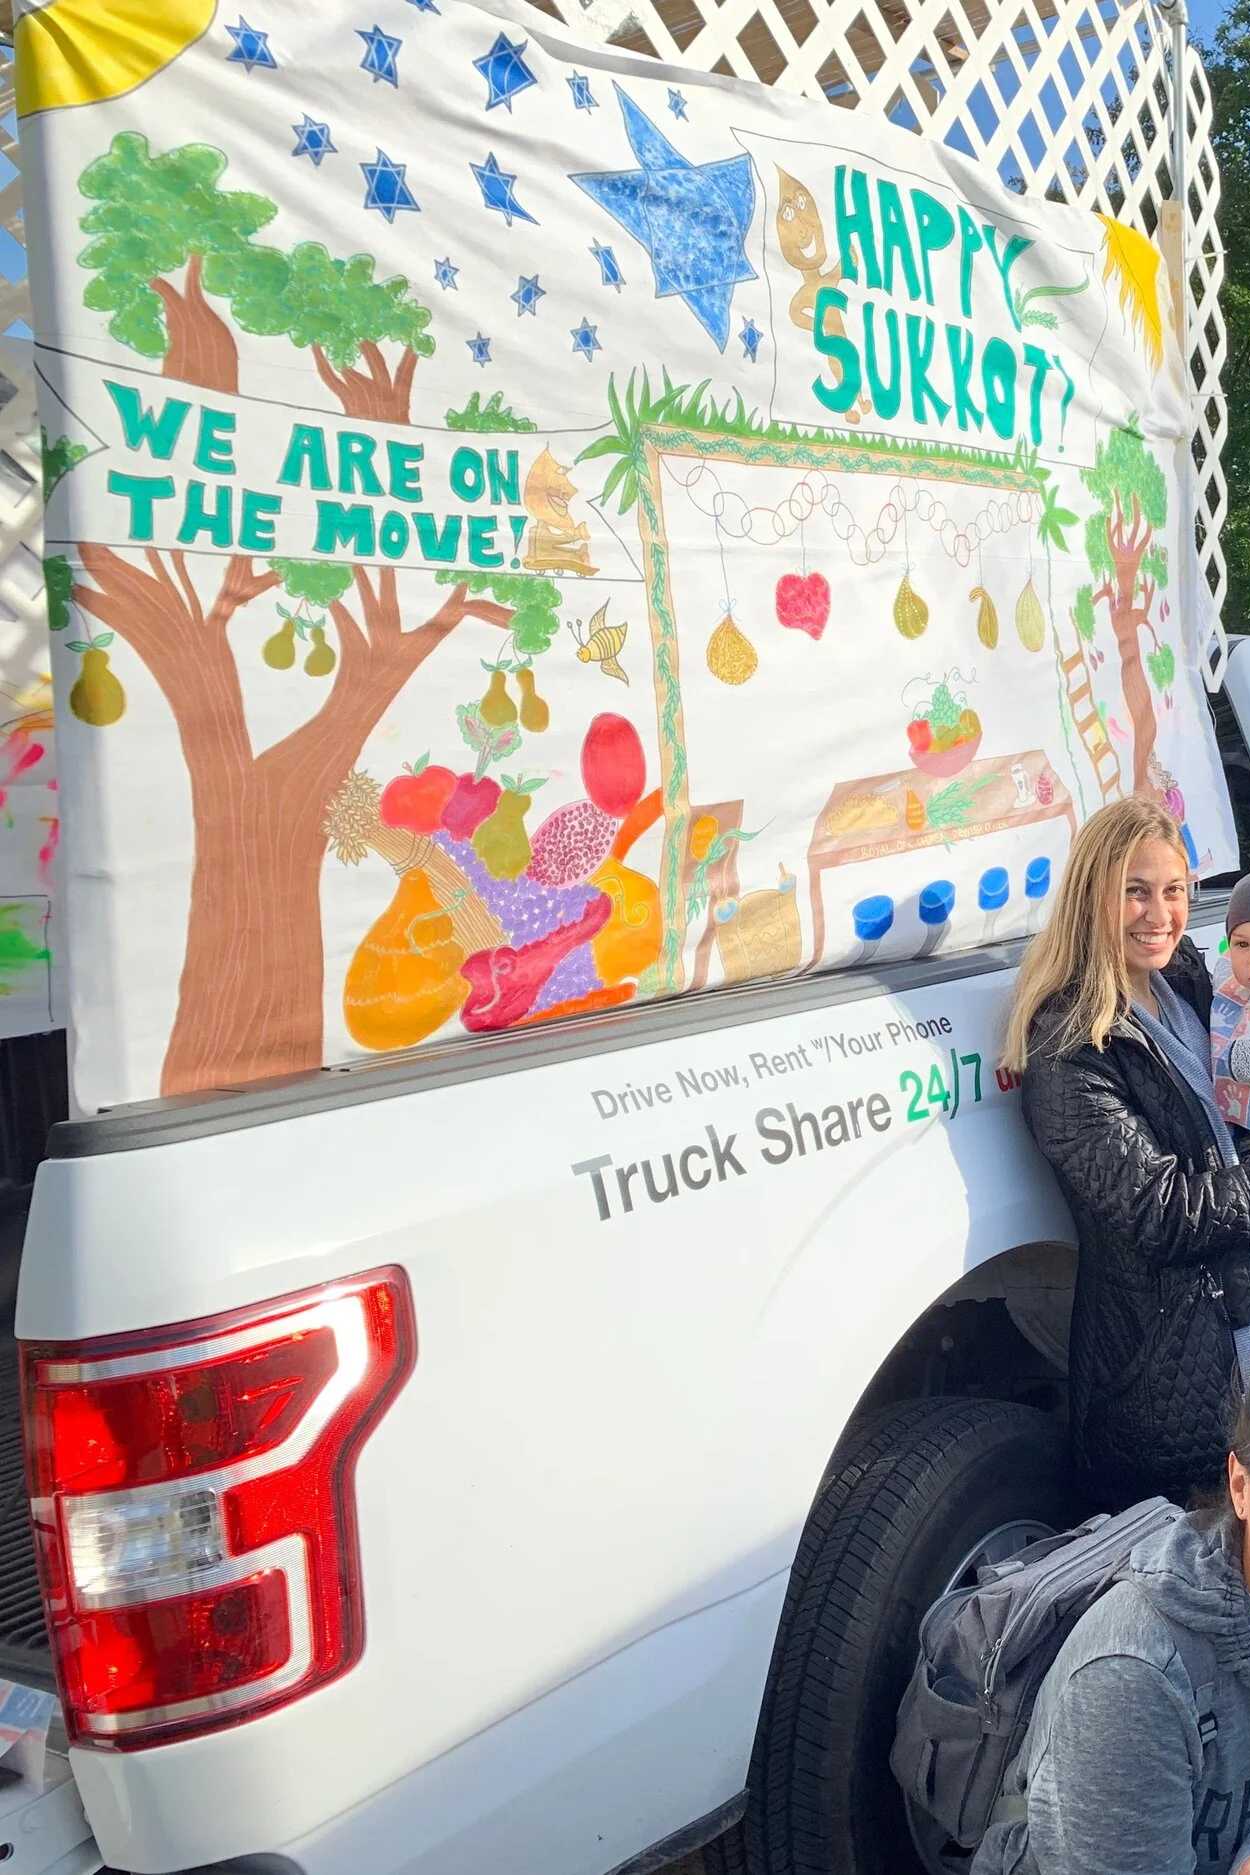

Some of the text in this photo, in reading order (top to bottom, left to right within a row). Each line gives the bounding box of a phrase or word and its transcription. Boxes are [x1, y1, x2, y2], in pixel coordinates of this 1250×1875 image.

[834, 165, 1036, 333] HAPPY
[812, 286, 1075, 454] SUKKOT!
[102, 379, 520, 505] WE ARE ON
[107, 469, 528, 570] THE MOVE!
[861, 844, 893, 857] ROYAL
[590, 1079, 673, 1120] Drive
[675, 1064, 749, 1099] Now,
[749, 1045, 812, 1081] Rent
[885, 1013, 953, 1047] Phone
[571, 1123, 748, 1222] Truck
[754, 1091, 892, 1166] Share
[899, 1047, 982, 1122] 24/7
